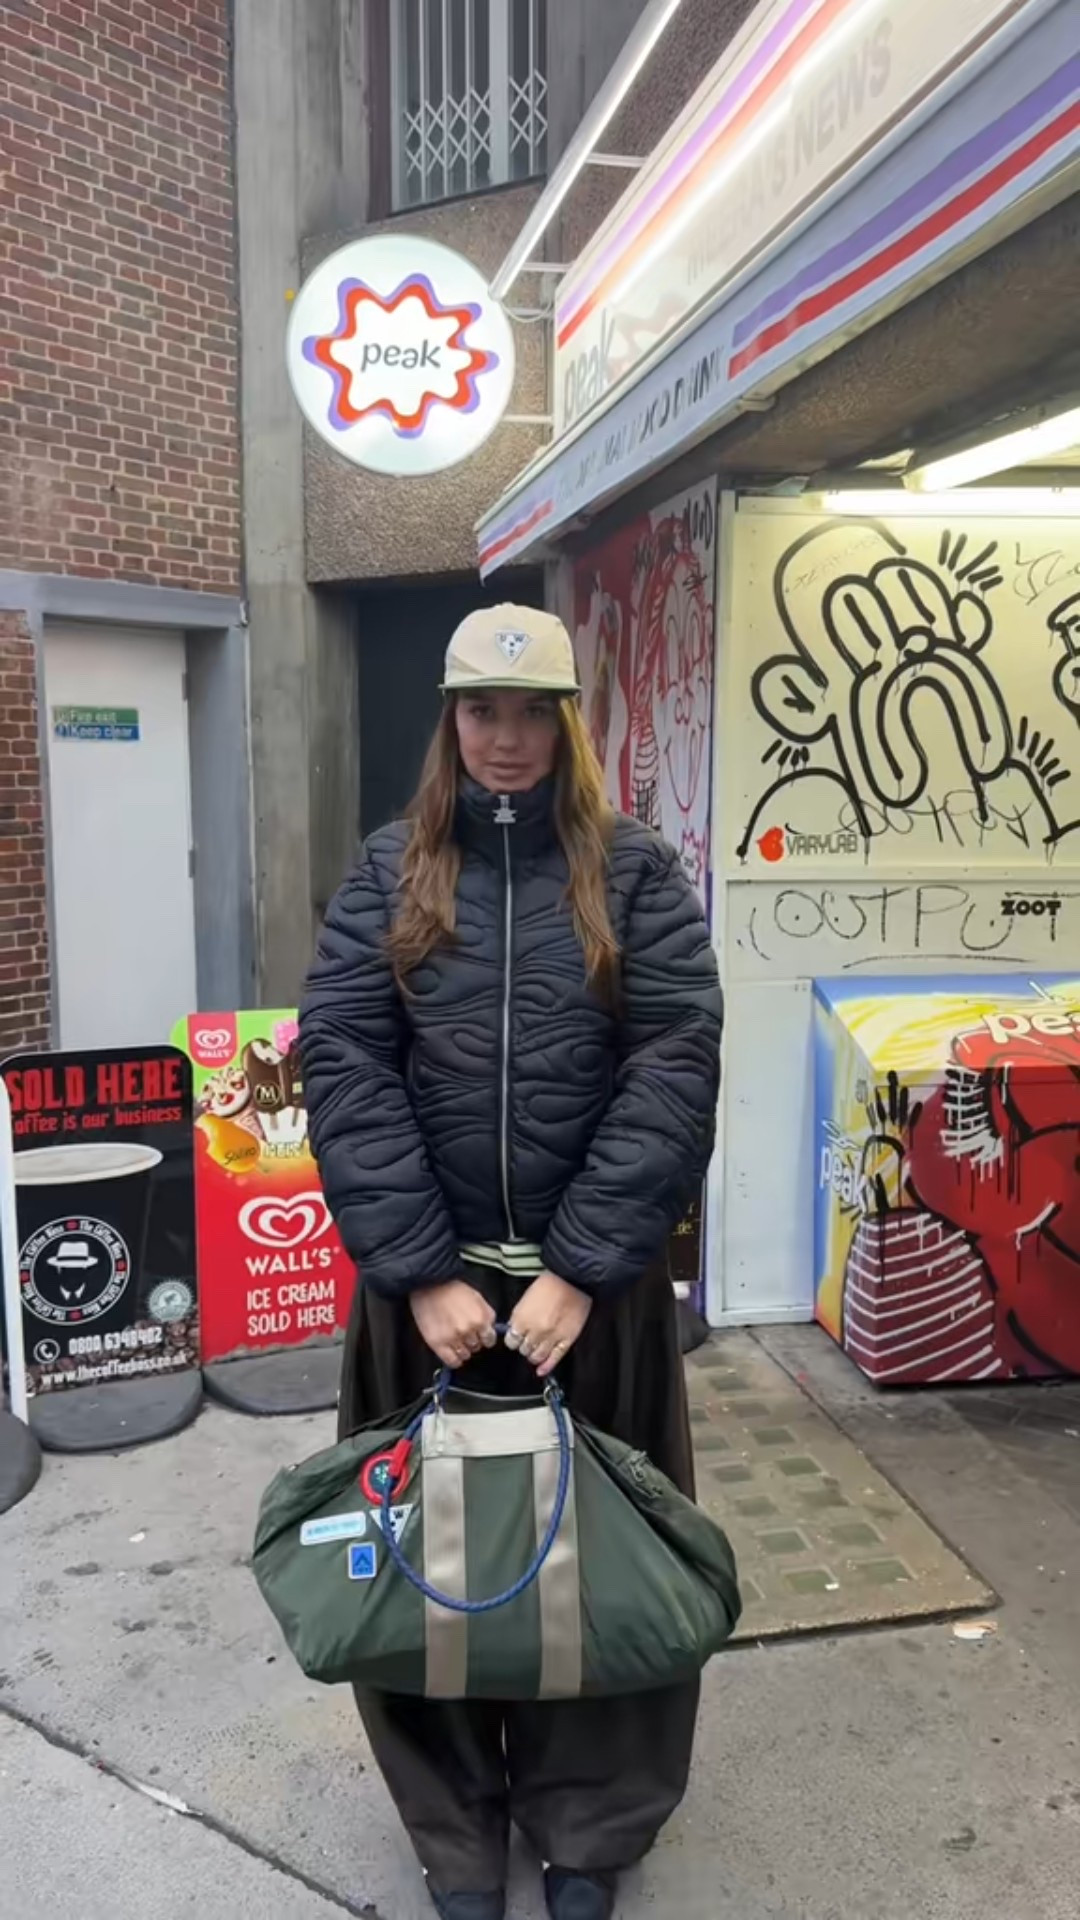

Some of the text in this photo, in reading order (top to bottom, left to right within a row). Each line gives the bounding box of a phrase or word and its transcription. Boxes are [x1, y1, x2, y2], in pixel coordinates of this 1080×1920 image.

[793, 17, 893, 177] NEWS
[360, 339, 441, 373] peak
[564, 308, 616, 429] peak
[71, 725, 132, 739] Keep clear
[786, 834, 857, 855] VARYLAB
[1001, 900, 1061, 915] ZOOT
[982, 1012, 1080, 1044] pe
[5, 1059, 182, 1112] SOLD HERE
[13, 1105, 182, 1134] offee is our business
[820, 1146, 868, 1216] peak
[245, 1247, 332, 1277] WALL'S
[247, 1278, 335, 1311] ICE CREAM
[247, 1304, 335, 1337] SOLD HERE
[69, 1335, 101, 1354] 0800
